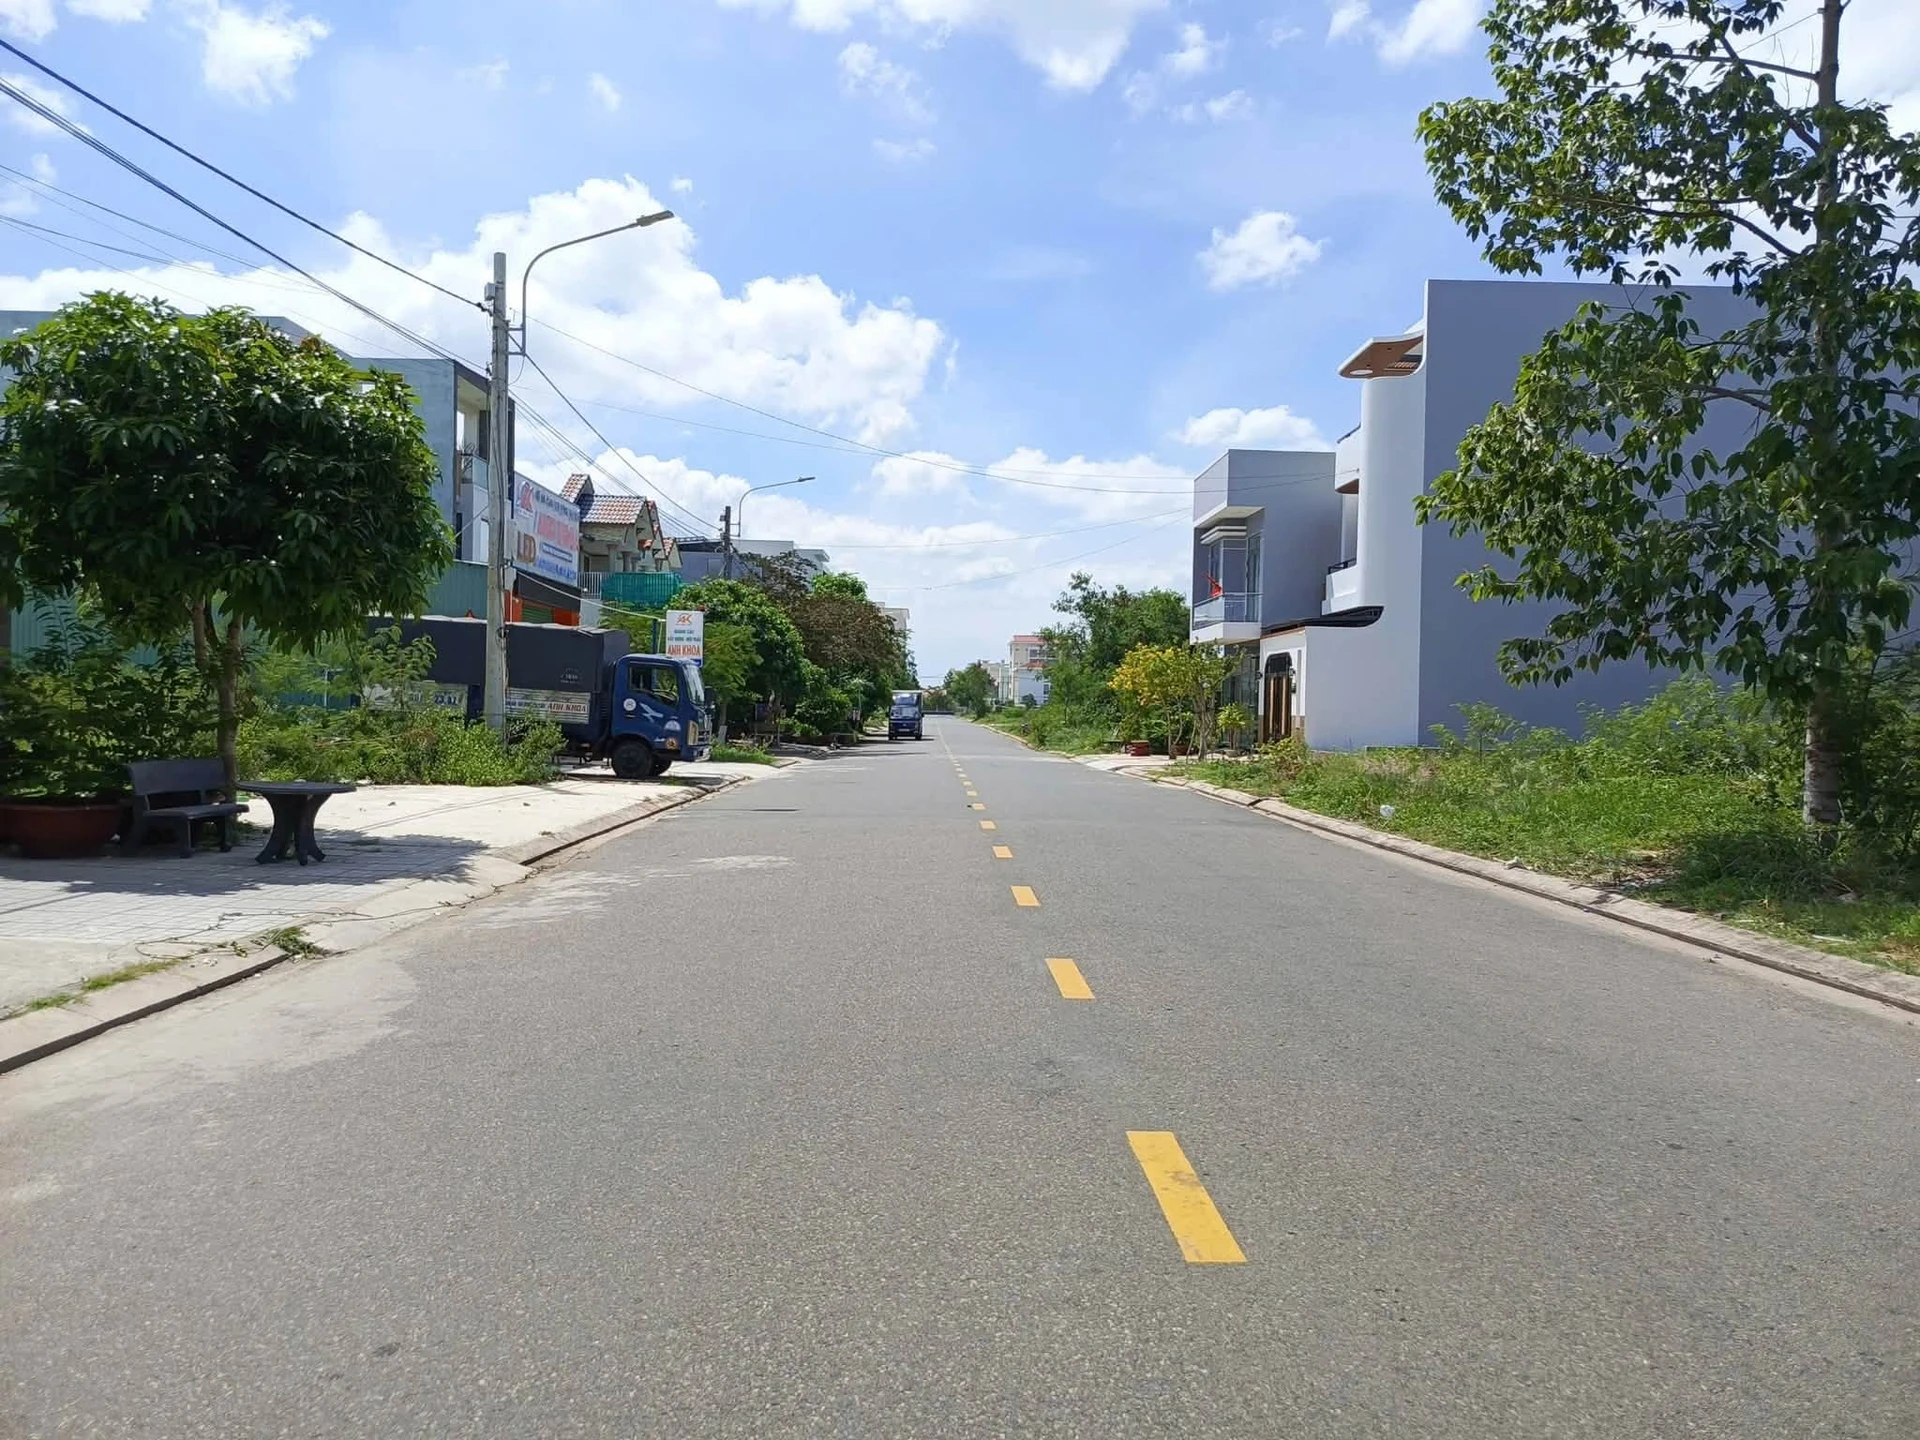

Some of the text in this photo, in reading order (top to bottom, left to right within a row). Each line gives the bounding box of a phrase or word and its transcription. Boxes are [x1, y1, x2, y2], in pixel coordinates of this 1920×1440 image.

[667, 645, 701, 656] ANH KHOA
[549, 702, 564, 712] ANH
[566, 703, 586, 712] KHOA
